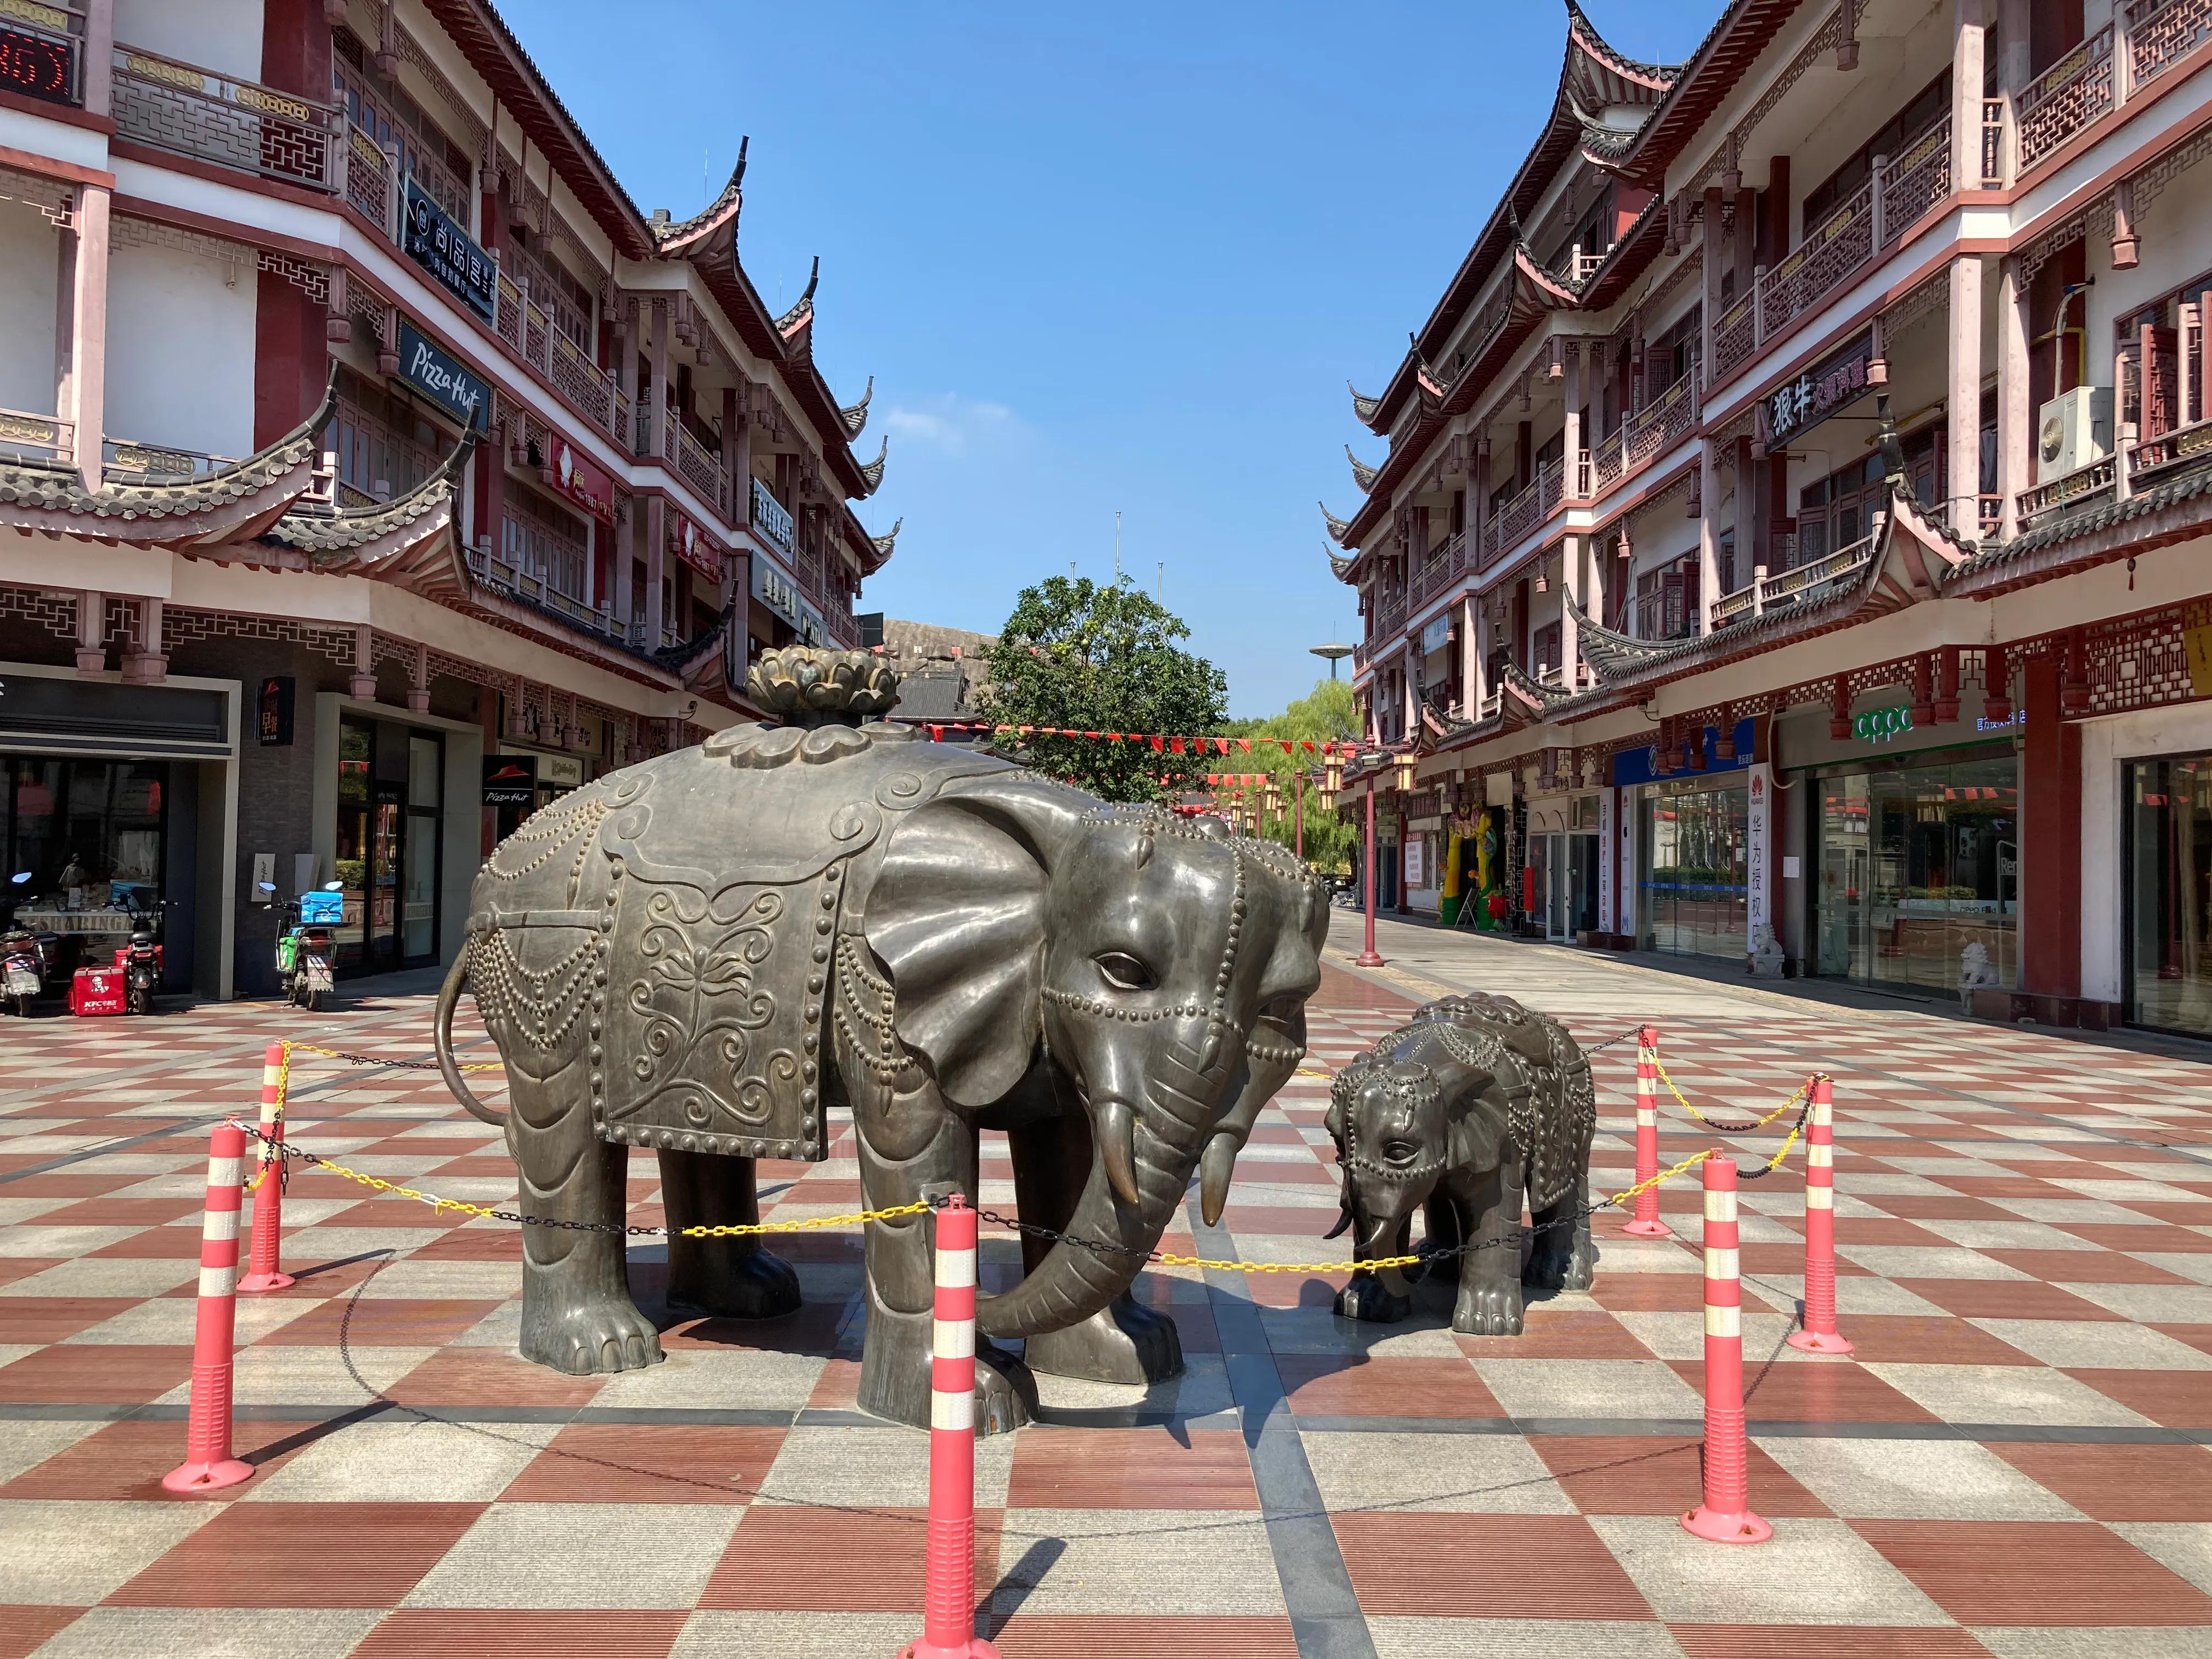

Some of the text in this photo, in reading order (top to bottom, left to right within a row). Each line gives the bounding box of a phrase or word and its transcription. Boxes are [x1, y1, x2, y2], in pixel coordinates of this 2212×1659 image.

[411, 342, 480, 412] Pizza Hut
[486, 793, 530, 802] Pizza Hut
[1751, 797, 1764, 805] HUAWEI
